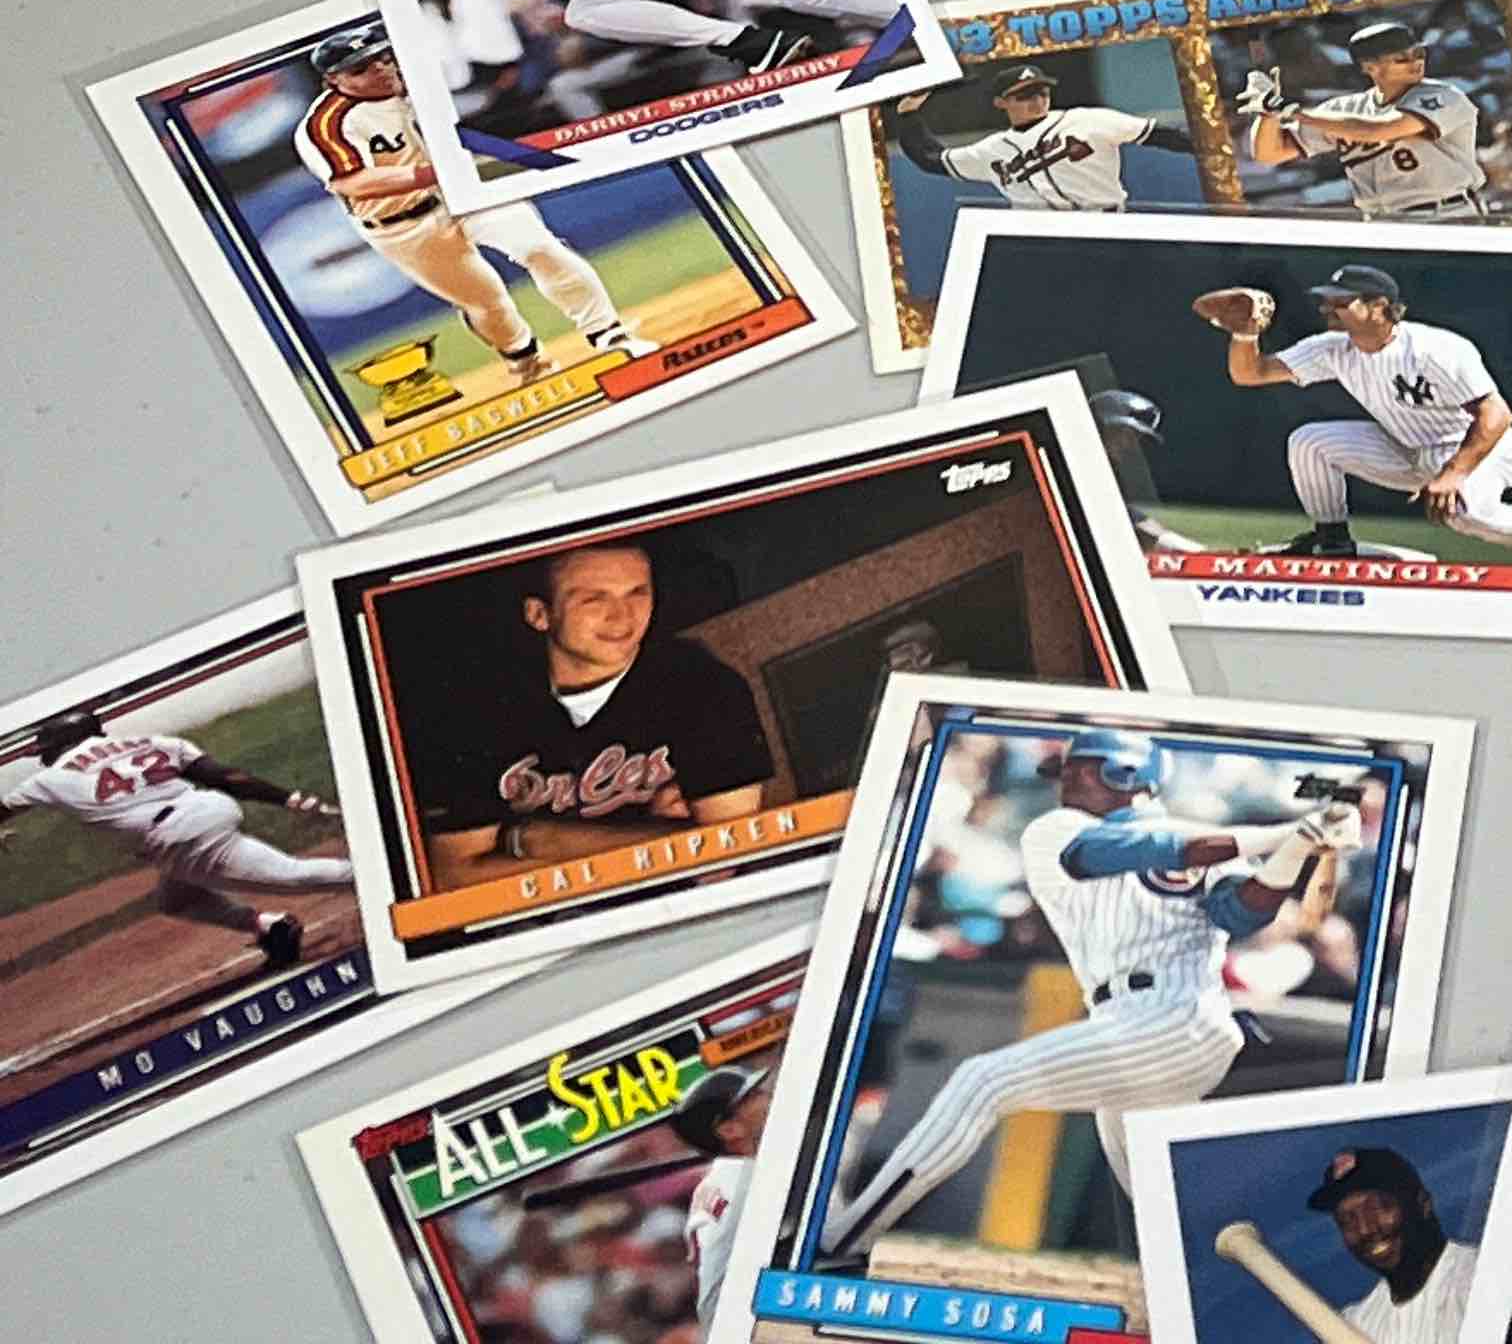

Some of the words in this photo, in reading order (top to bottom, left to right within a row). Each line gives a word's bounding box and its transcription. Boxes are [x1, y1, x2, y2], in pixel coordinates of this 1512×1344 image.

[555, 103, 657, 142] DARRYL
[669, 55, 842, 113] STRAWBERRY
[628, 93, 785, 145] DODGERS
[1393, 148, 1419, 172] 8
[662, 328, 747, 372] Astros
[363, 441, 428, 475] JEFF
[447, 376, 578, 443] BAGWELL
[1198, 584, 1365, 606] YANKEES
[1213, 557, 1488, 583] MATTINGLY
[96, 750, 180, 803] 42
[521, 862, 596, 899] CAL
[633, 806, 800, 872] RIPKEN
[97, 1054, 155, 1093] MO
[184, 963, 361, 1053] VAUGHN
[432, 1107, 548, 1199] ALL
[547, 1048, 685, 1145] STAR
[778, 1279, 920, 1320] SAMMY
[943, 1297, 1050, 1335] SOSA
